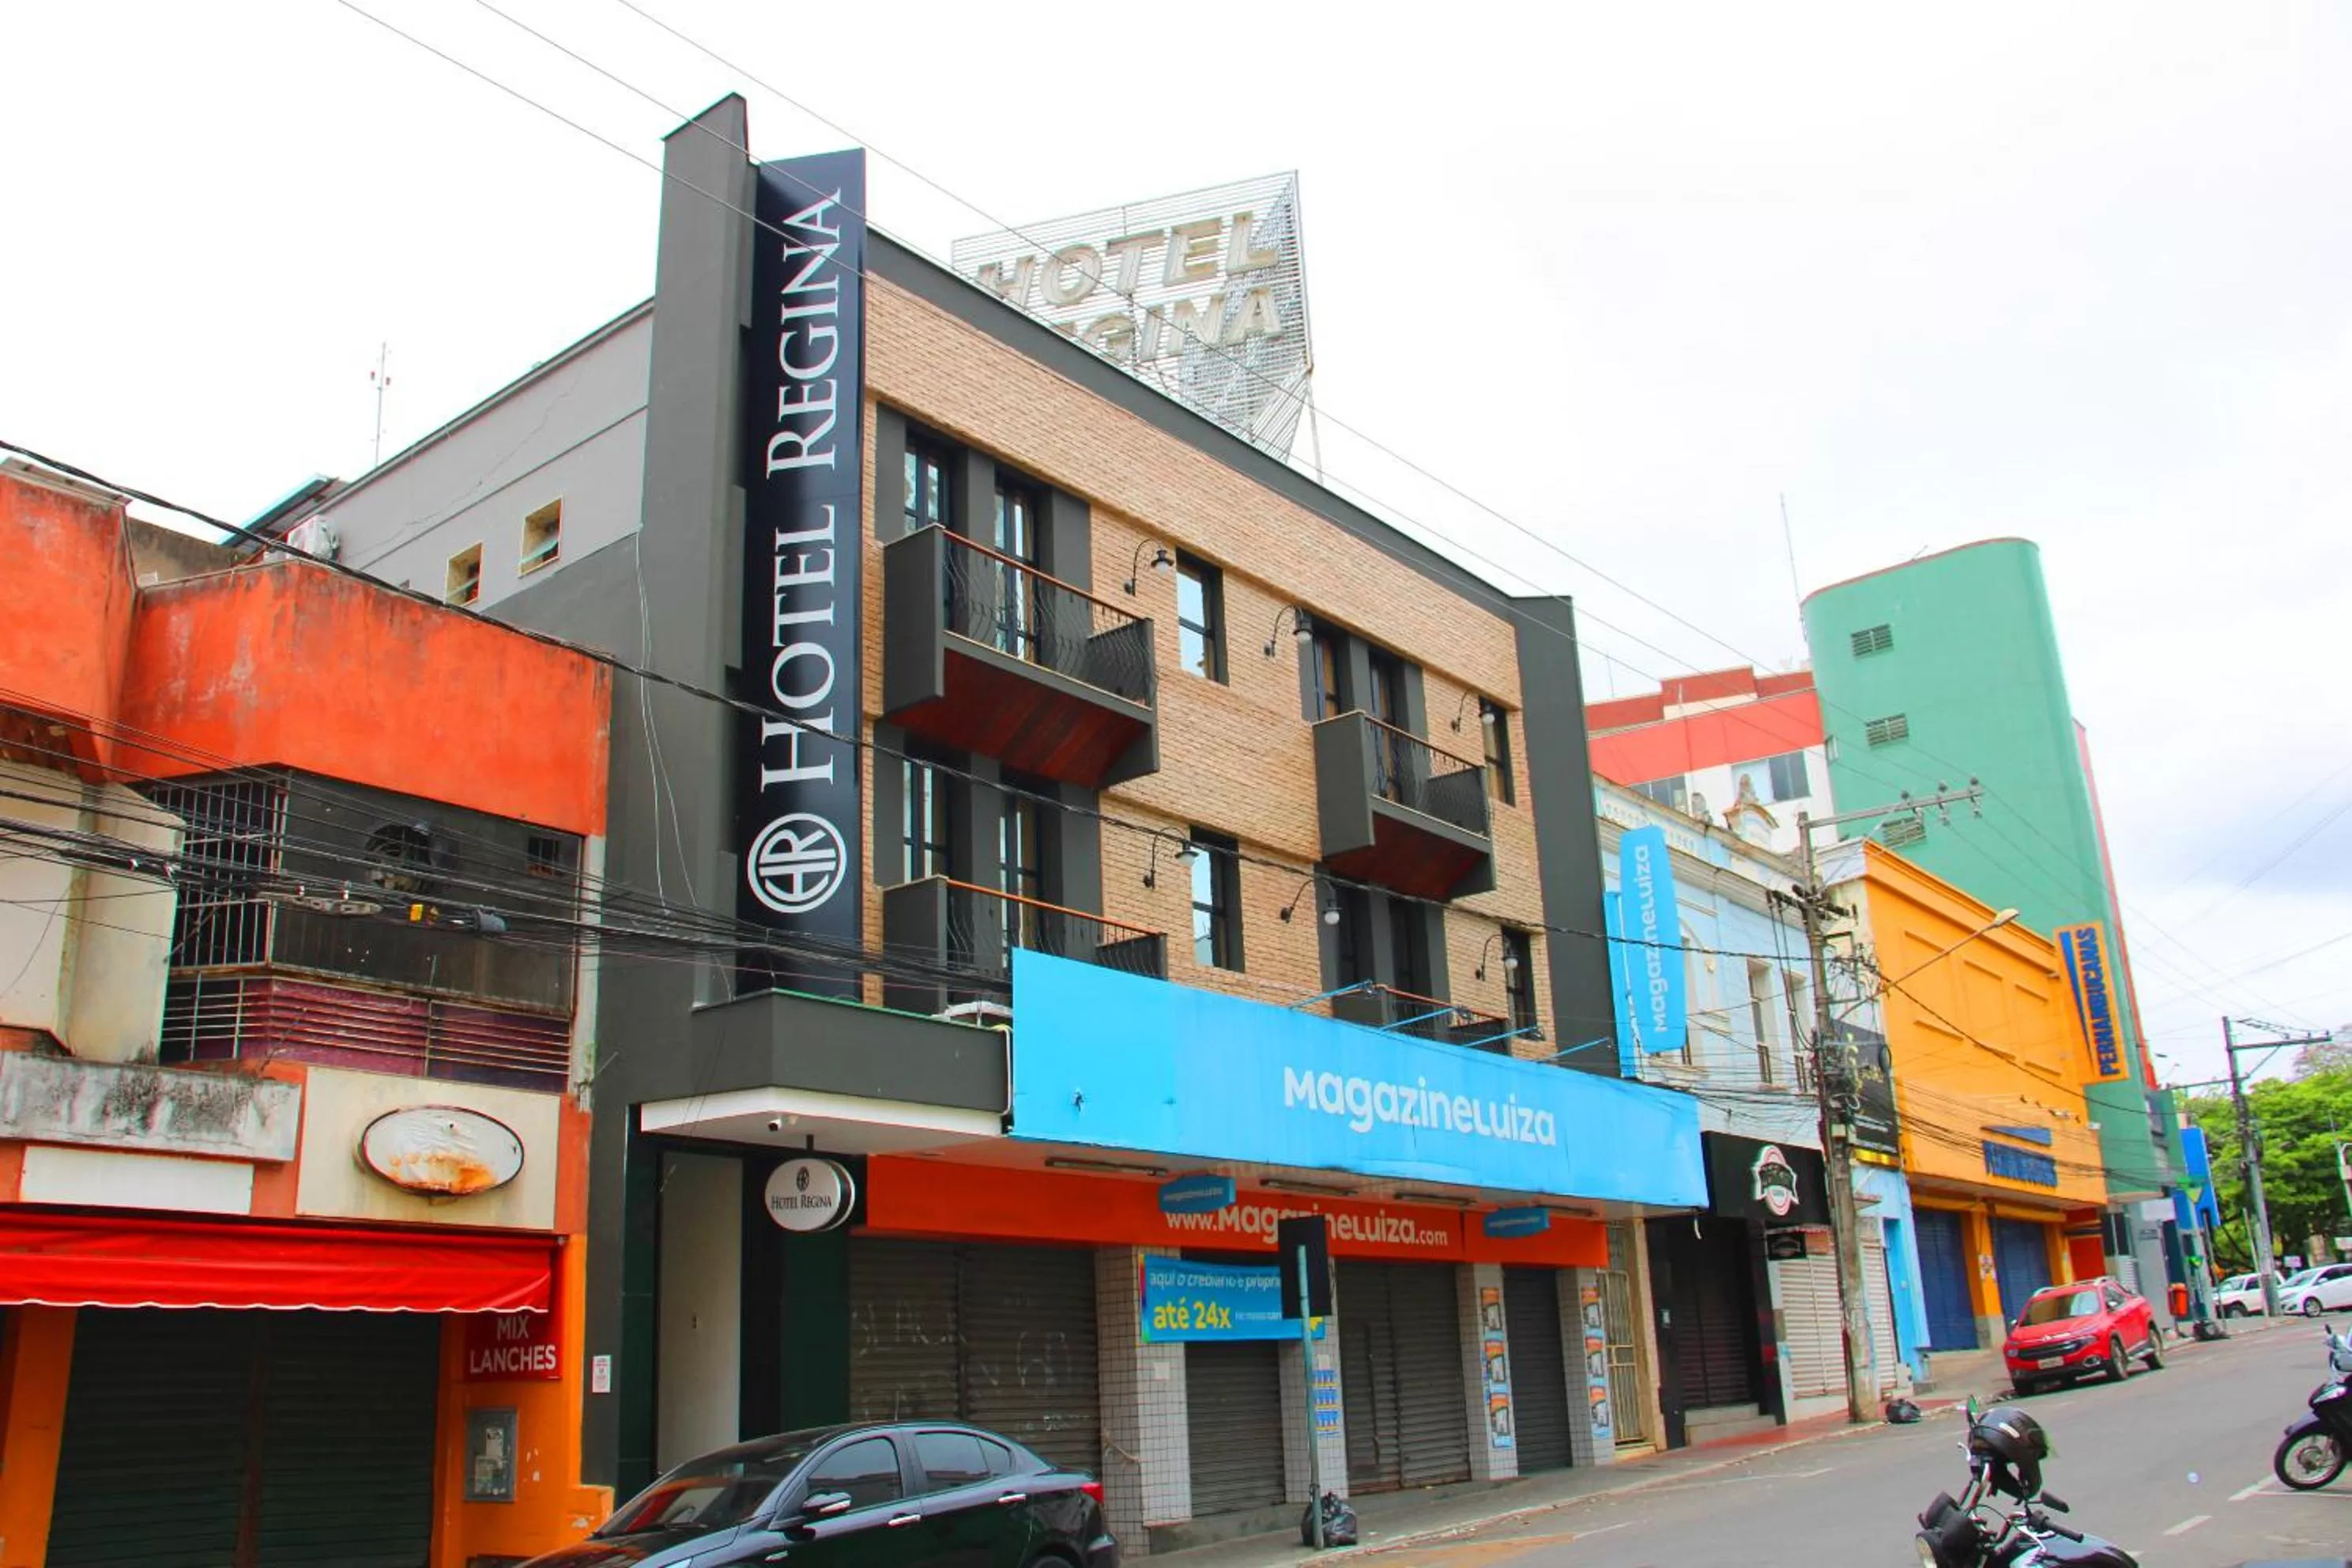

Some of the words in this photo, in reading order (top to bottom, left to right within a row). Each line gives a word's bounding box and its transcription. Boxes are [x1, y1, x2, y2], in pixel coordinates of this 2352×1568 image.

[976, 210, 1280, 309] HOTEL
[765, 187, 842, 479] REGINA
[1052, 285, 1282, 364] GINA
[760, 503, 835, 793] HOTEL
[2076, 927, 2120, 1076] PERNAMBUCANAS
[771, 1195, 798, 1210] HOTEL
[800, 1194, 832, 1208] REGINA
[1166, 1202, 1449, 1246] www.MagneLuiza.com
[496, 1315, 529, 1341] MIX
[1153, 1296, 1189, 1330] até
[1193, 1301, 1232, 1329] 24x
[469, 1345, 556, 1374] LANCHES
